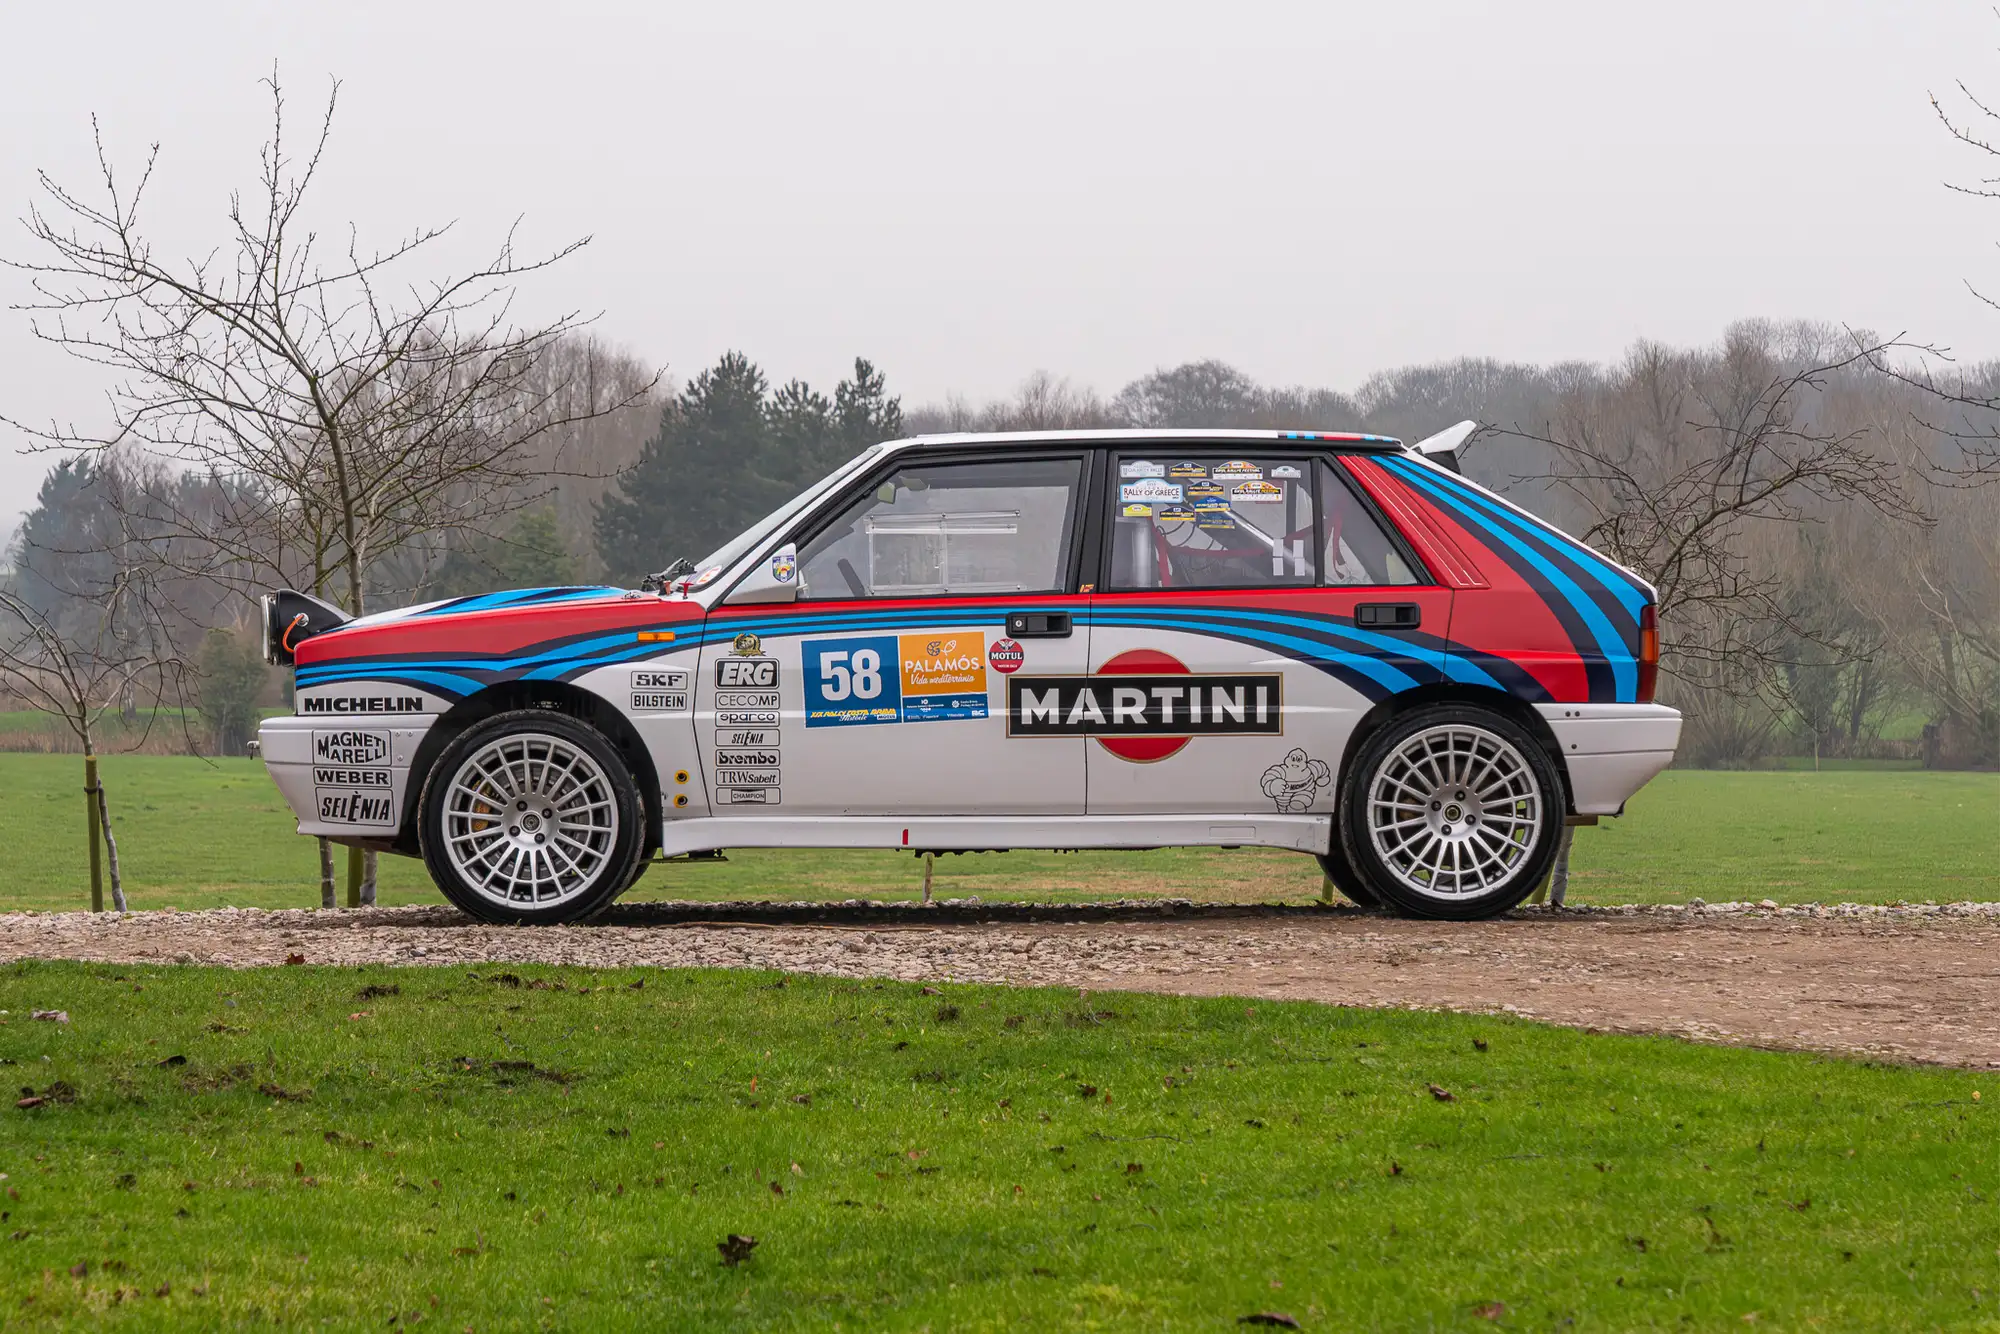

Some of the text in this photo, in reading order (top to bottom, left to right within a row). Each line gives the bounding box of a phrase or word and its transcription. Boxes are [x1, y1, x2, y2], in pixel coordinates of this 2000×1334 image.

[1124, 488, 1142, 496] RALLY
[1155, 488, 1179, 496] GREECE
[991, 652, 1022, 660] MOTUL
[636, 674, 683, 686] SKF
[720, 662, 775, 686] ERG
[820, 649, 882, 701] 58
[304, 697, 423, 712] MICHELIN
[634, 695, 684, 708] BILSTEIN
[718, 695, 777, 706] CECOMP
[1021, 687, 1268, 724] MARTINI
[720, 713, 776, 724] sparco
[318, 732, 386, 754] MAGNETI
[318, 745, 386, 764] MARELLI
[718, 751, 777, 765] brembo
[316, 770, 389, 785] WEBER
[321, 791, 390, 822] SELÈNIA
